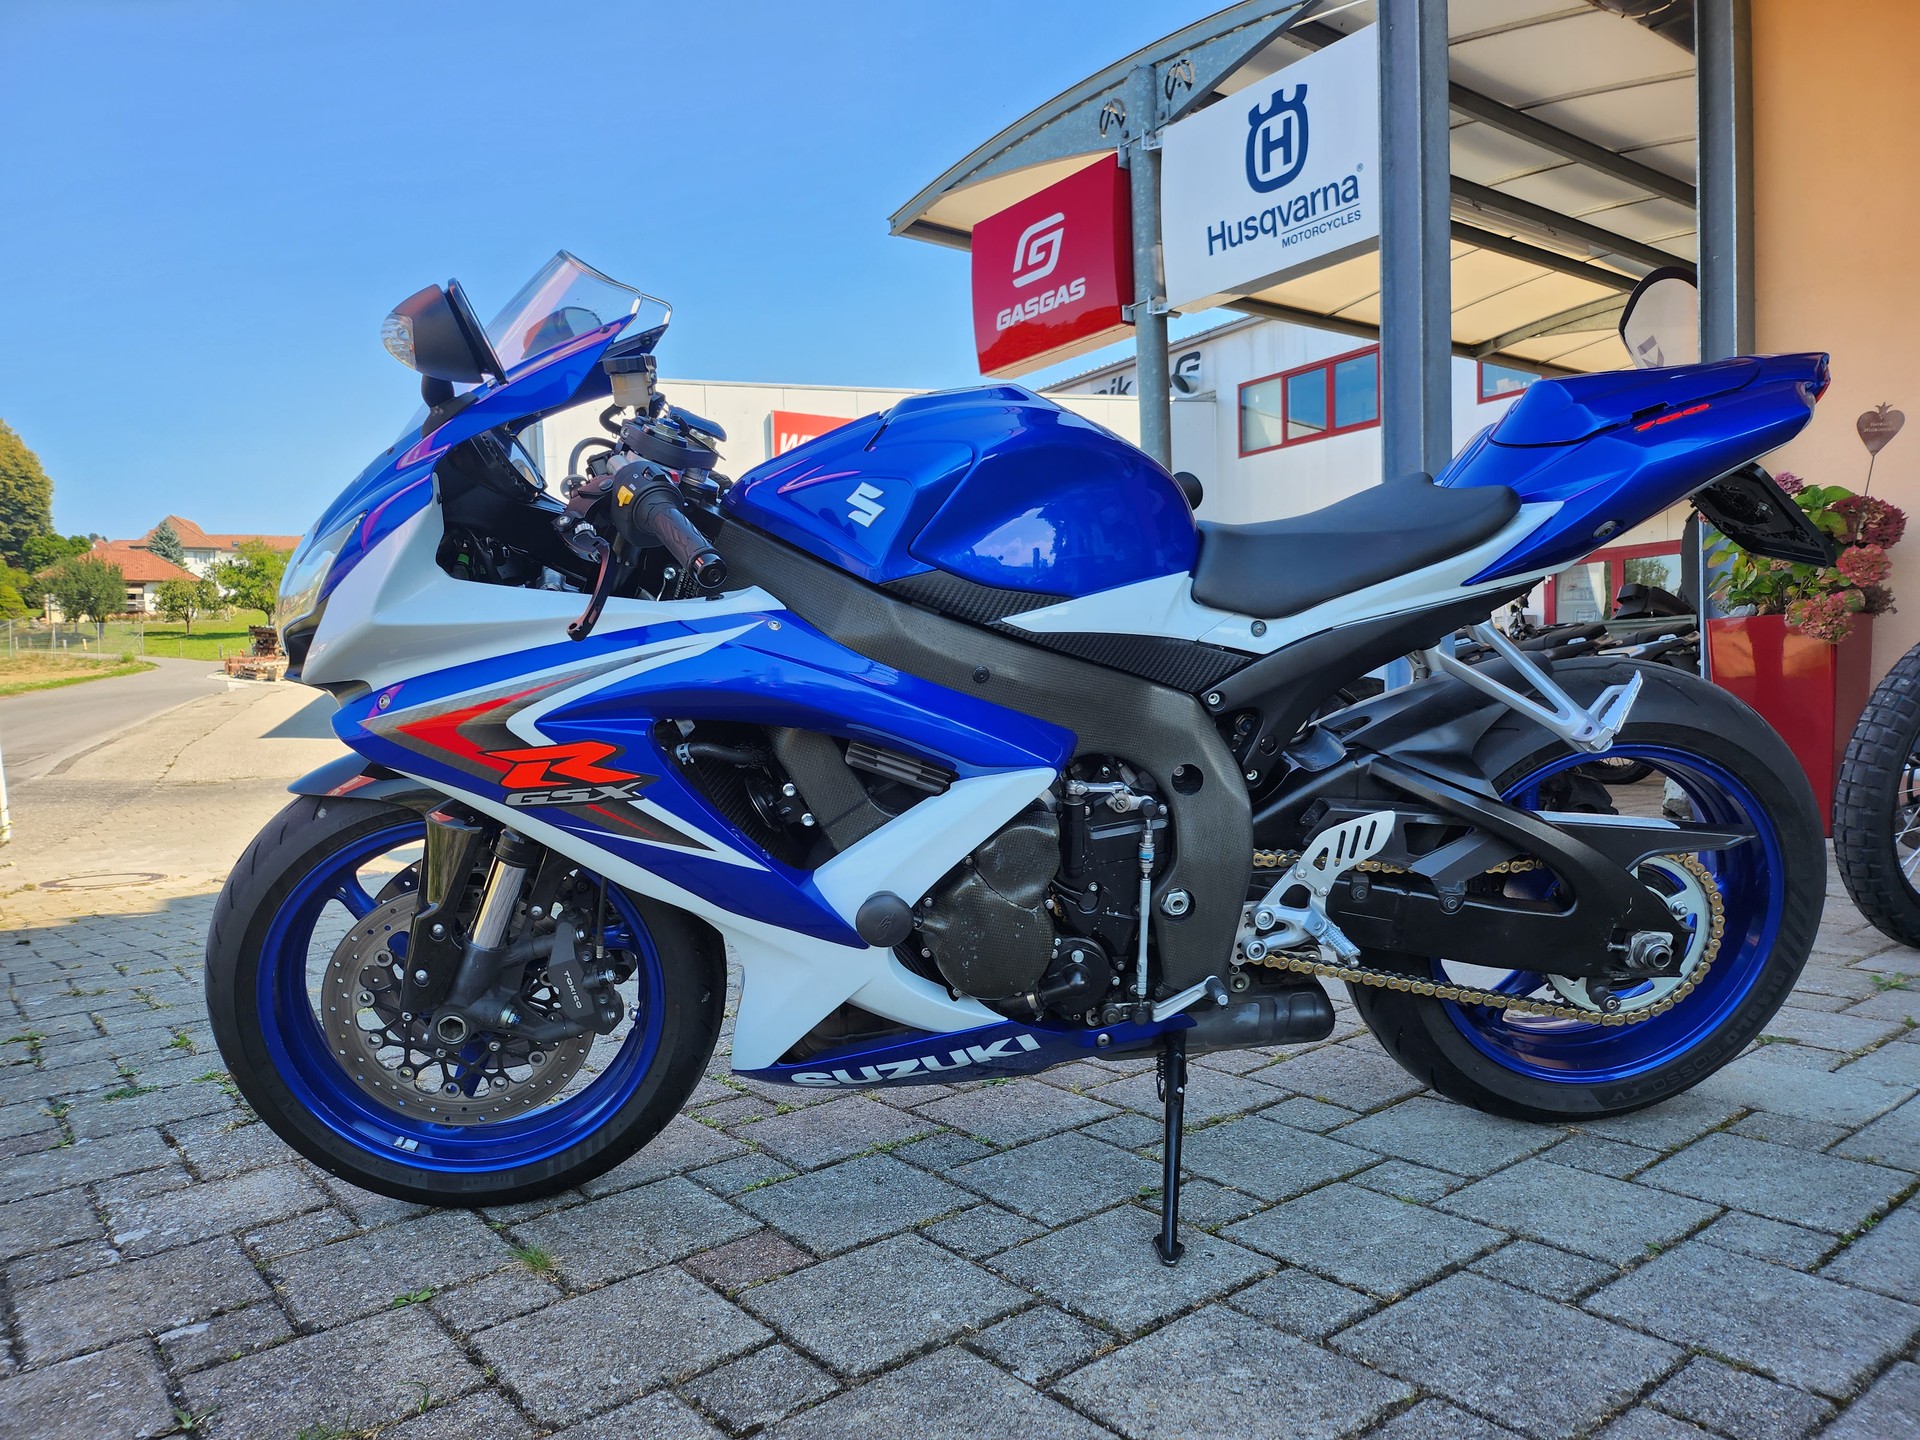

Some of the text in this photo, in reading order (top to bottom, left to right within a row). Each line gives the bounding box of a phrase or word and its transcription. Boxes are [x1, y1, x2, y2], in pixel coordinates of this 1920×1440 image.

[1207, 174, 1360, 257] Husqvarna
[1281, 209, 1362, 248] MOTORCYCLES
[996, 277, 1086, 331] GASGAS
[504, 781, 643, 807] GSX
[563, 970, 583, 1009] TOKICO
[1724, 972, 1788, 1046] DIABLO
[790, 1033, 1041, 1086] SUZUKI
[1651, 1046, 1724, 1092] ROSSO
